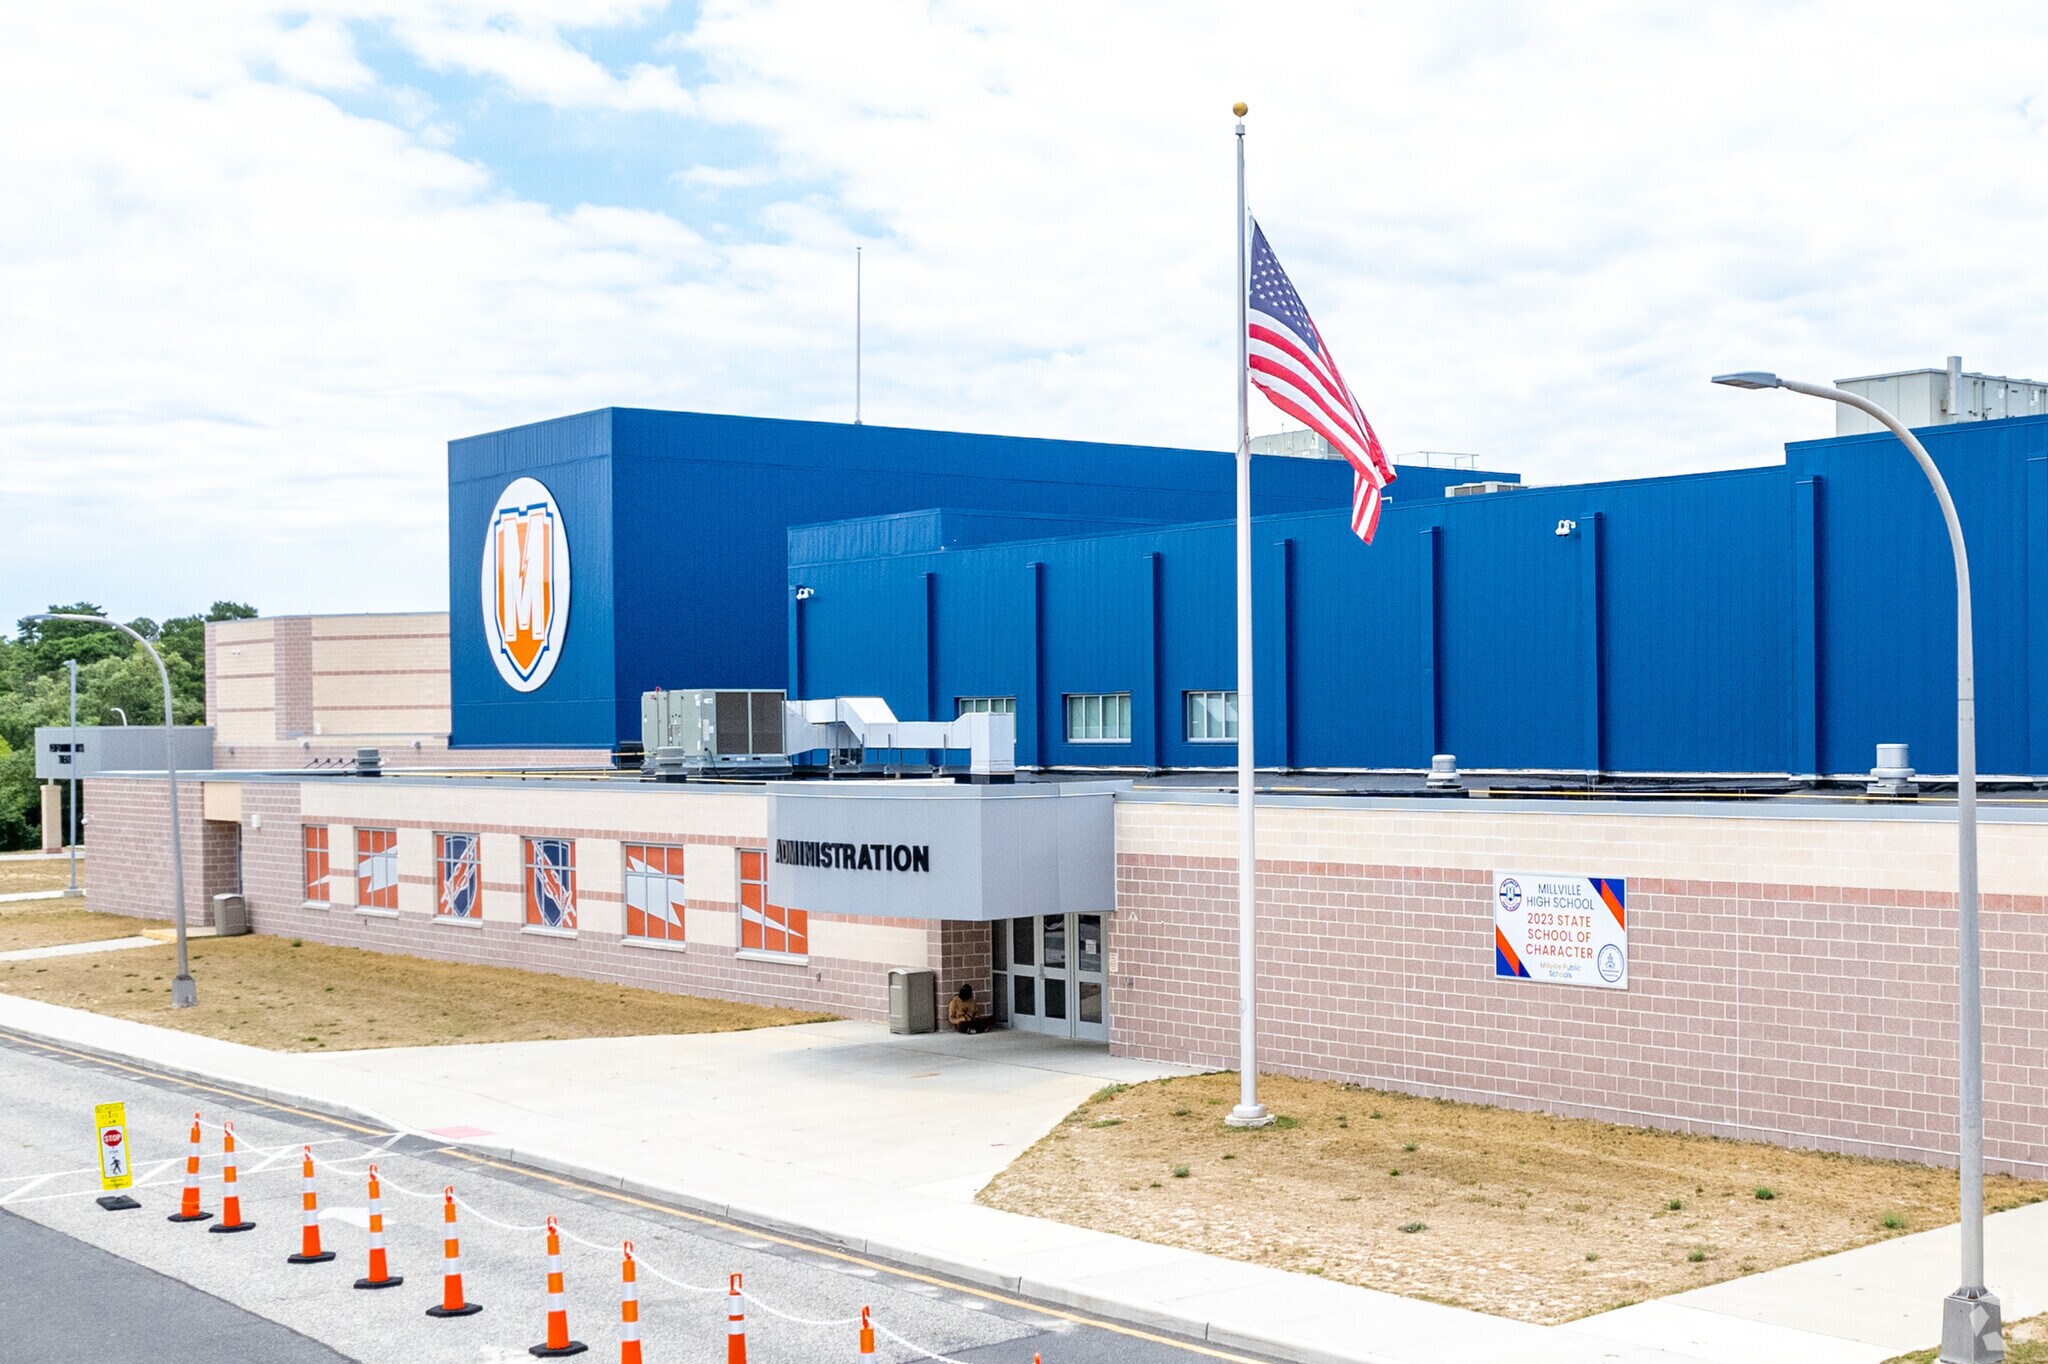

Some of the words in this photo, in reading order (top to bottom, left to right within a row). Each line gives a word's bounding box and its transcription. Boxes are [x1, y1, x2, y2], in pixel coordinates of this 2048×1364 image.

[775, 838, 930, 872] ADMINISTRATION
[1538, 884, 1581, 896] MILLVILLE
[1526, 896, 1551, 907] HIGH
[1553, 897, 1595, 910] SCHOOL
[1527, 912, 1554, 926] 2023
[1557, 914, 1591, 928] STATE
[1527, 928, 1573, 942] SCHOOL
[1576, 931, 1592, 943] OF
[1525, 943, 1593, 959] CHARACTER
[1548, 970, 1573, 979] Schools
[104, 1133, 122, 1143] STOP
